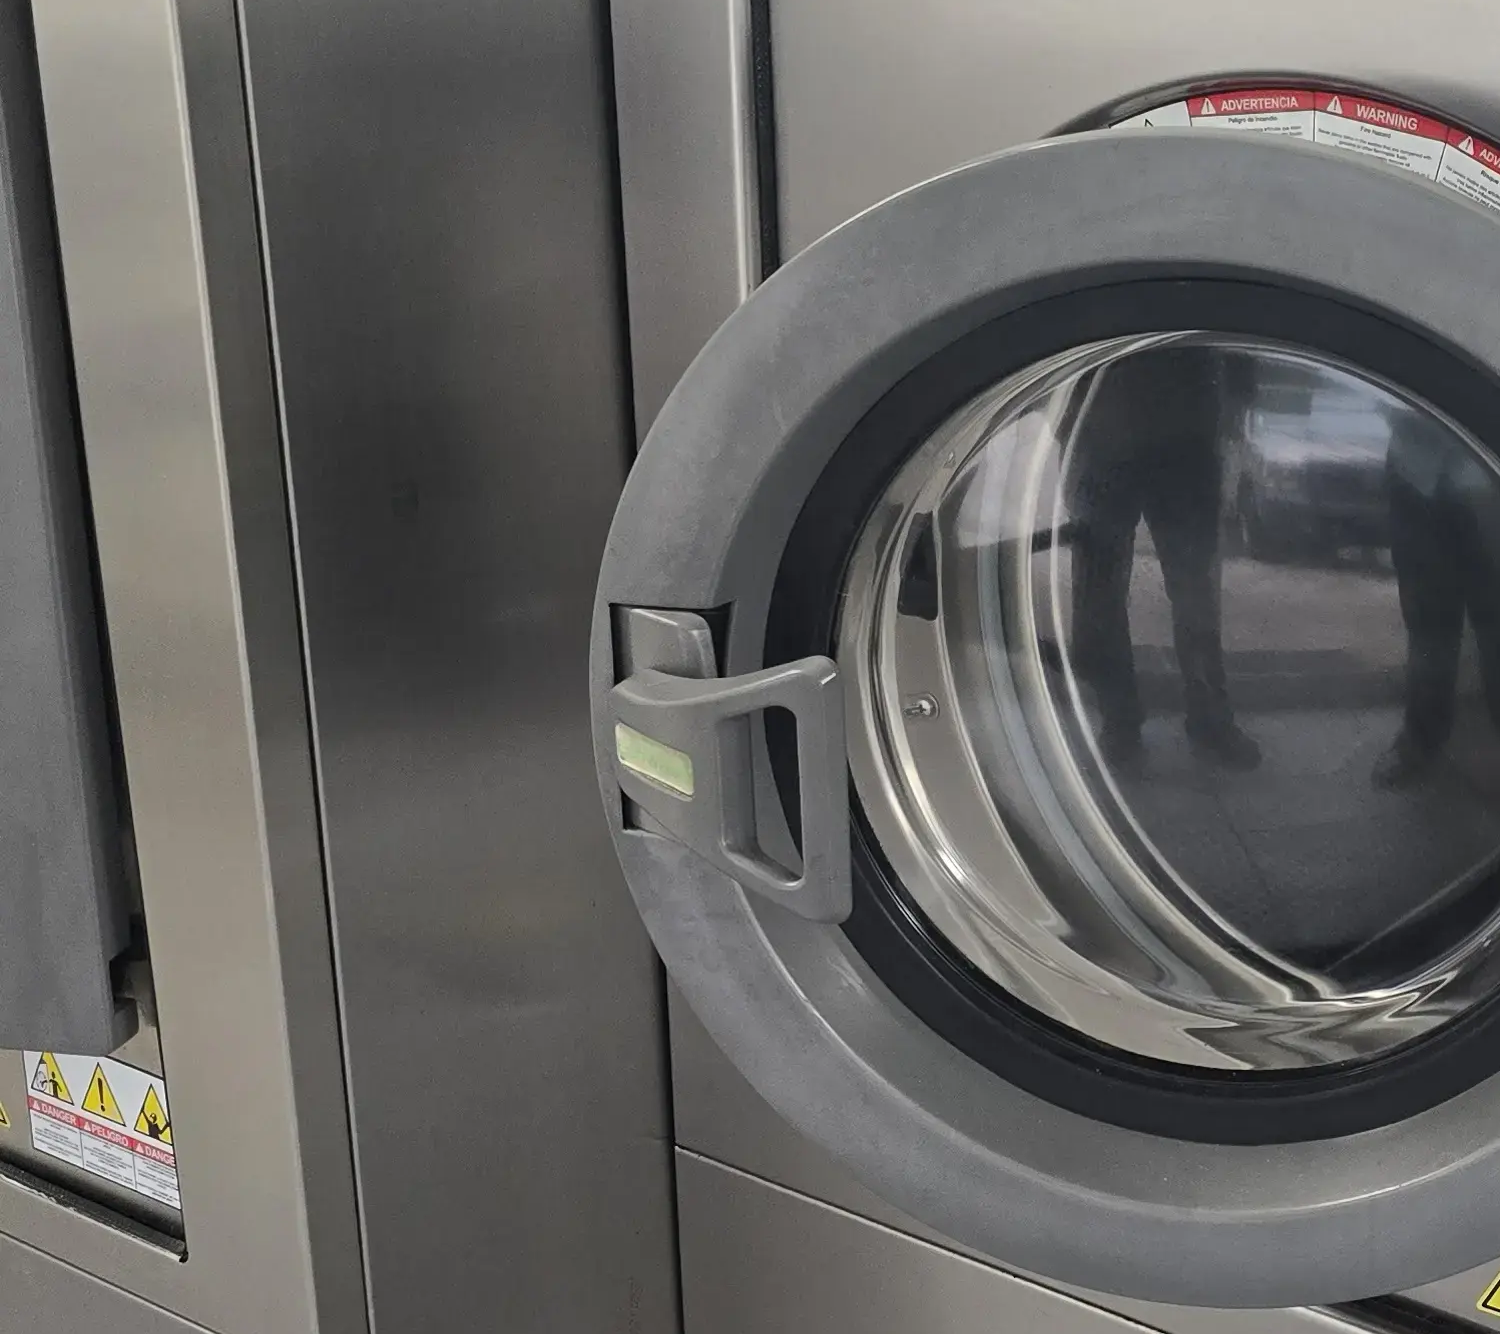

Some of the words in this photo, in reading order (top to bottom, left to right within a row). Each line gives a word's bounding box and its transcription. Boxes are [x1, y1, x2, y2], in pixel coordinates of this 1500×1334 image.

[1221, 96, 1299, 112] ADVERTENCIA
[1356, 104, 1418, 131] WARNING
[41, 1103, 77, 1126] DANGER
[92, 1123, 129, 1147] PELIGRO
[145, 1146, 175, 1166] DANGE
